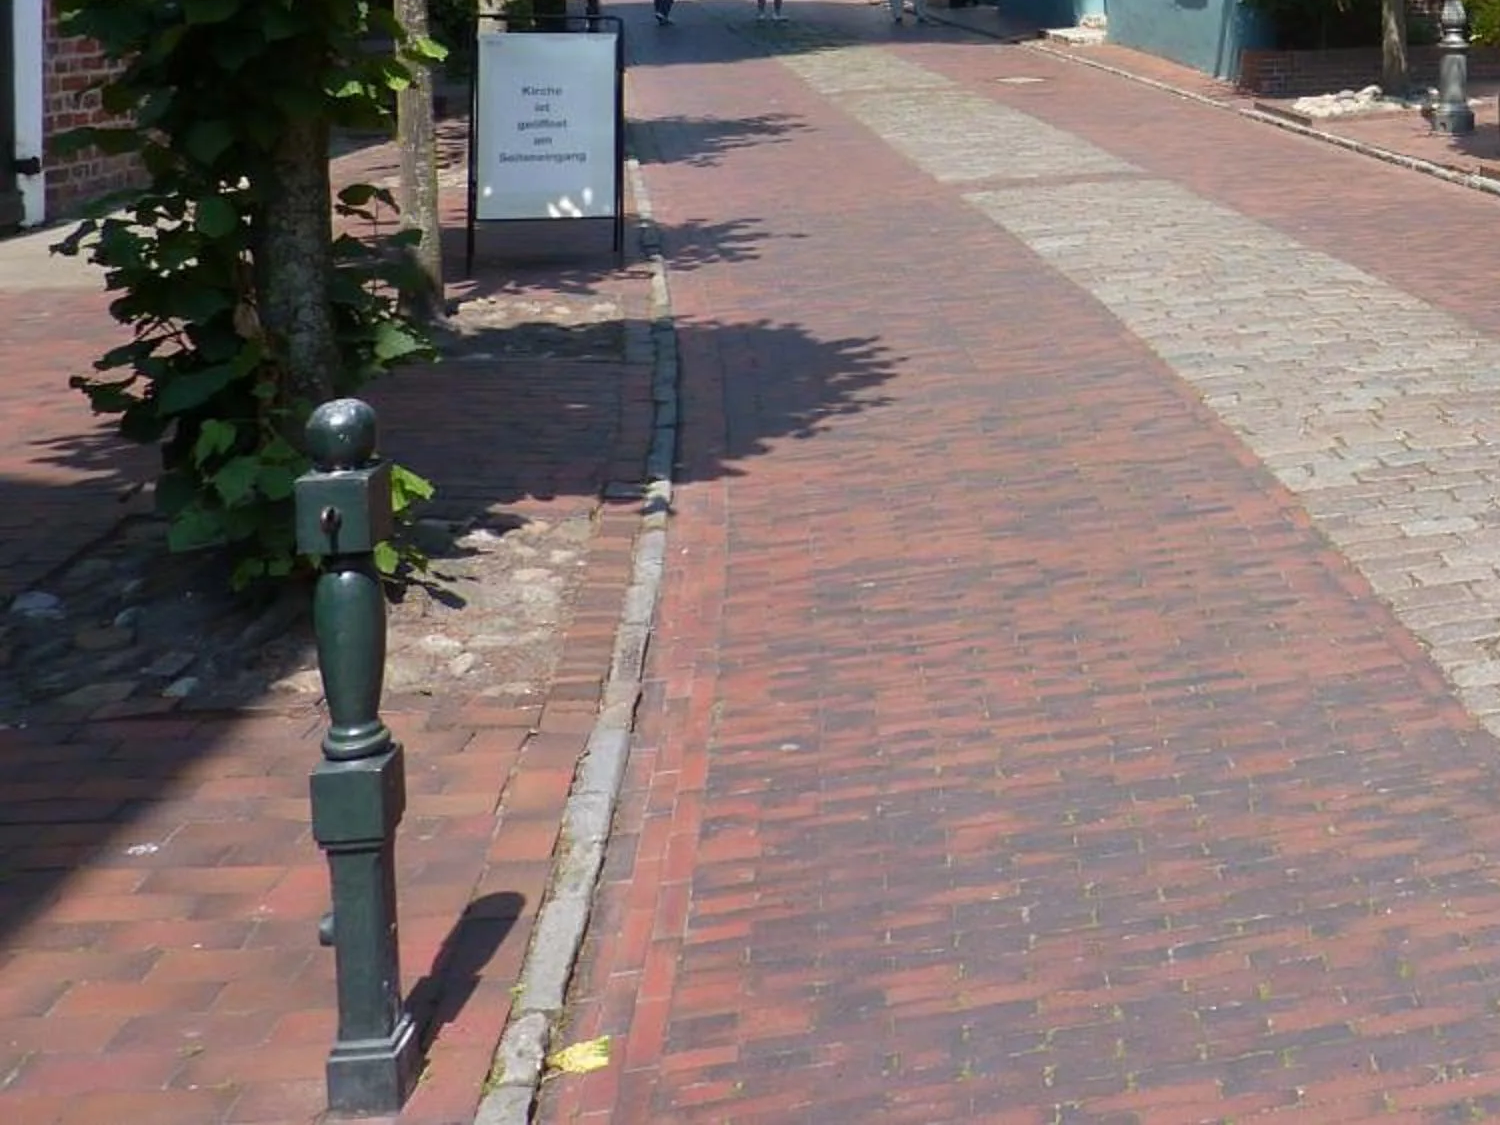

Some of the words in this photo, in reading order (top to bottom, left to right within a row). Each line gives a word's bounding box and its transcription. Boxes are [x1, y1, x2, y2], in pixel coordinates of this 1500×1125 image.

[521, 86, 563, 96] Kirche
[534, 103, 550, 112] ist
[517, 119, 567, 131] geöffnet
[533, 137, 553, 146] am
[499, 152, 586, 163] Seiteneingang
